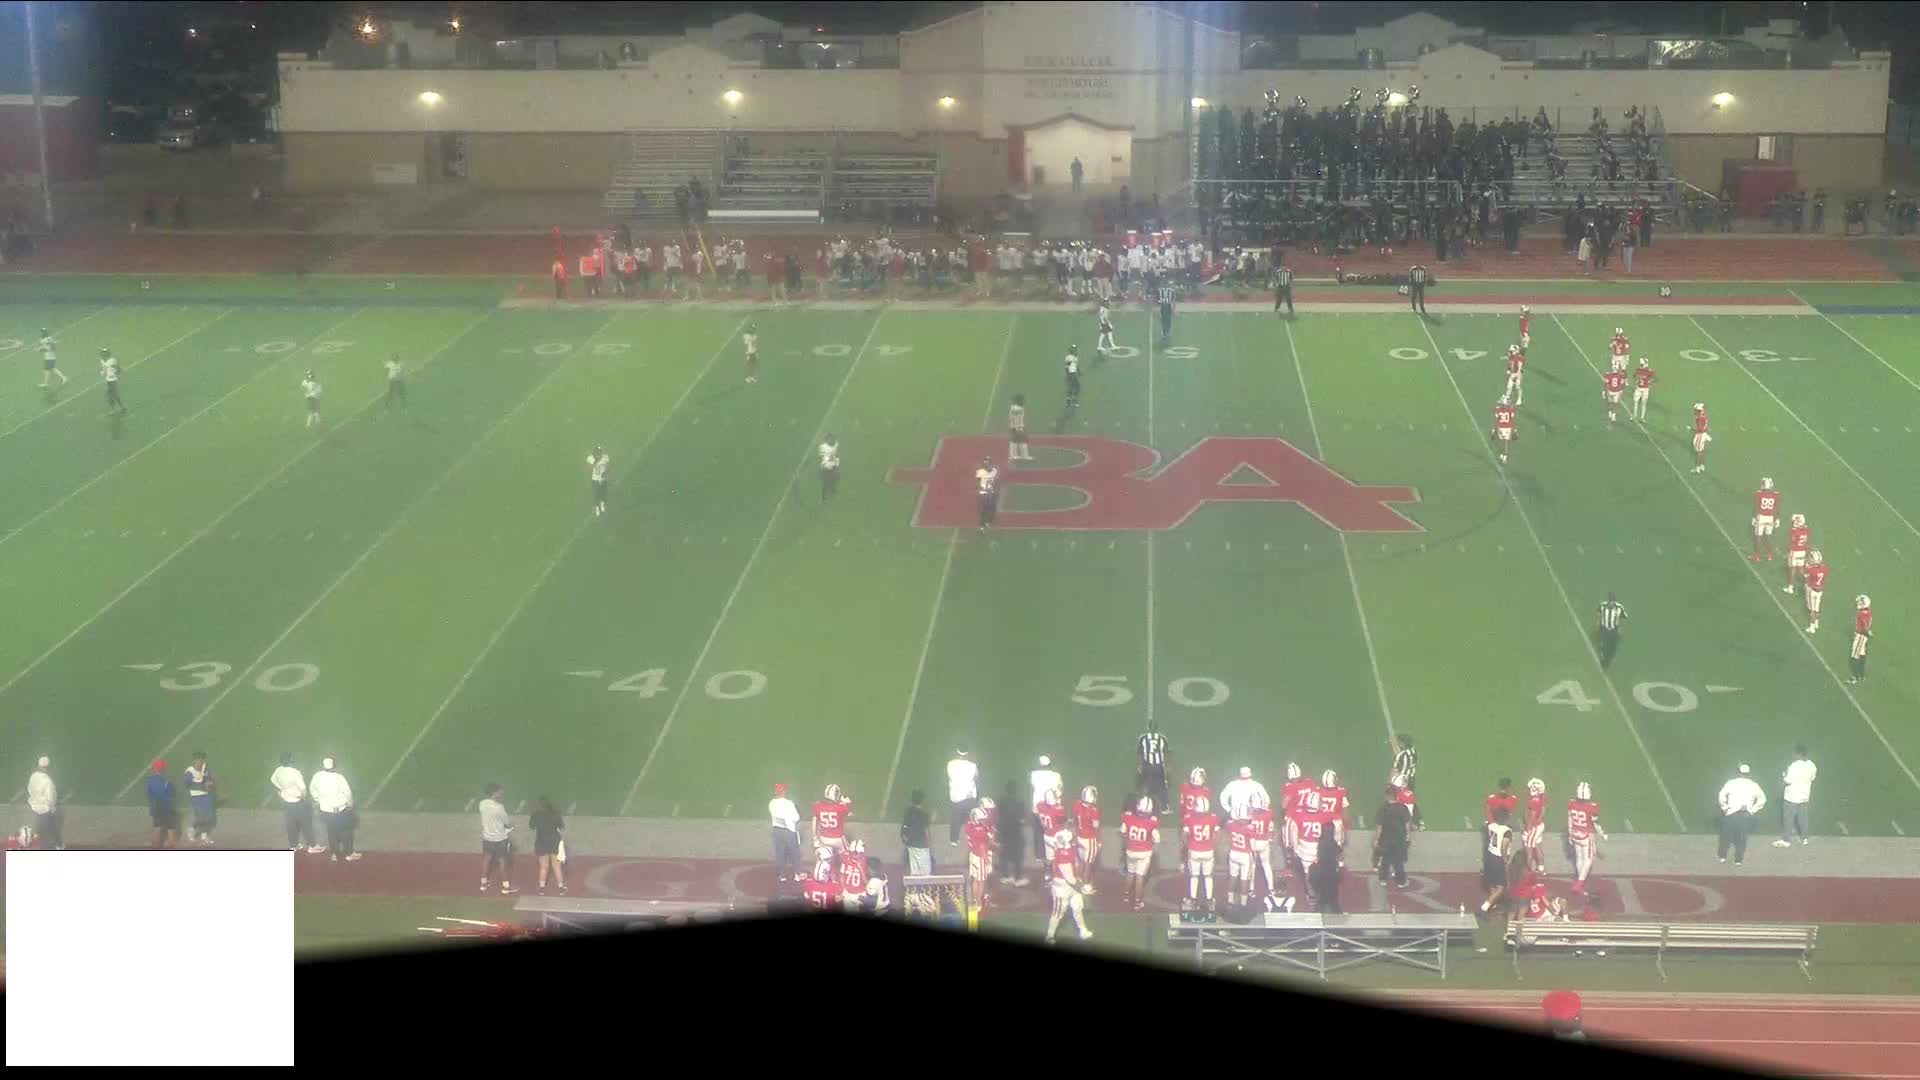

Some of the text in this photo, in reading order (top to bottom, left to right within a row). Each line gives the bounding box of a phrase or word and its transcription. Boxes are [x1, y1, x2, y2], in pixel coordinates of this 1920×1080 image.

[1398, 284, 1409, 295] 40
[1498, 412, 1510, 423] 30
[884, 436, 1426, 532] BA
[1815, 572, 1824, 586] 7
[159, 662, 321, 692] 30
[607, 668, 768, 699] 40
[1071, 675, 1231, 707] 50
[1536, 679, 1699, 713] 40
[1149, 740, 1158, 753] F
[820, 812, 837, 828] 55
[1129, 826, 1147, 842] 60
[1193, 825, 1210, 842] 54
[1303, 822, 1321, 838] 79
[846, 871, 860, 887] 70
